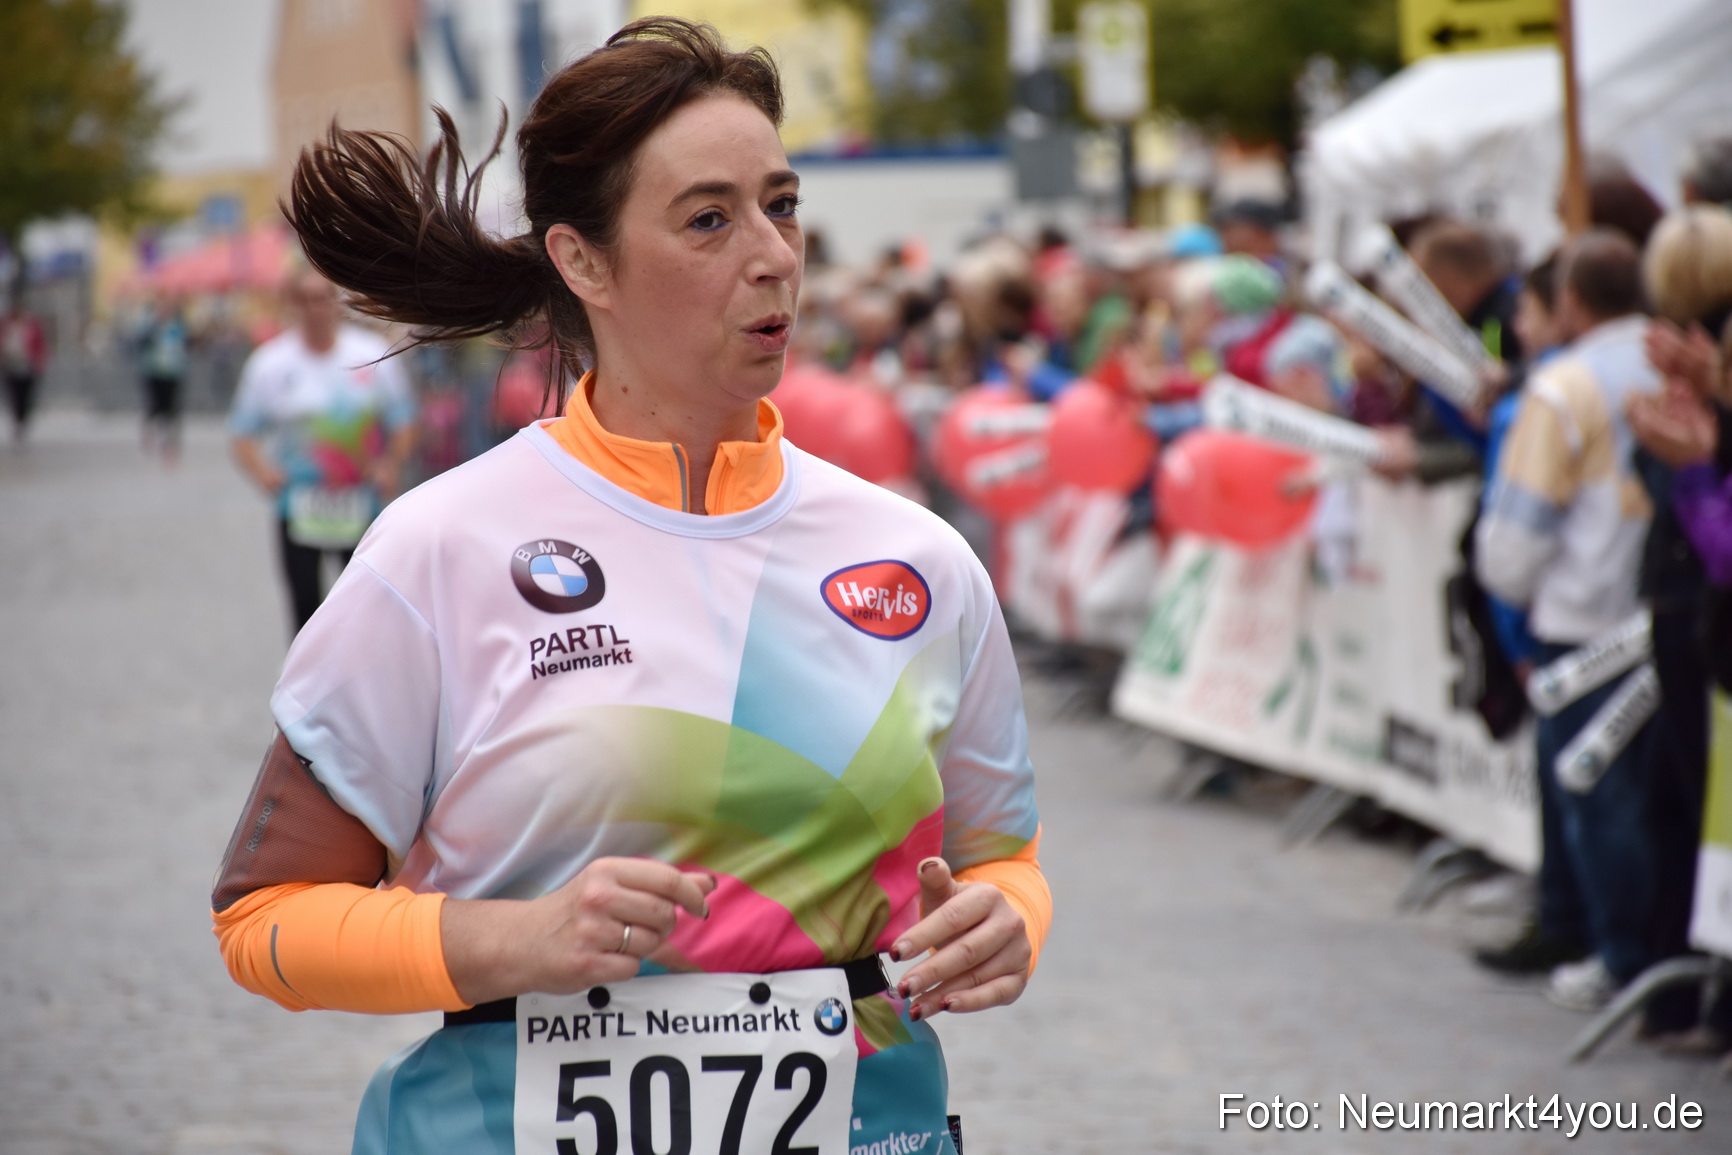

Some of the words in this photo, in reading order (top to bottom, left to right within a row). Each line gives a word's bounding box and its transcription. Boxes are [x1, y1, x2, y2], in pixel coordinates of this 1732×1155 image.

[515, 541, 592, 565] BMW
[835, 581, 918, 619] Hervis
[852, 608, 884, 622] SPORTS
[529, 624, 630, 661] PARTL
[530, 648, 633, 680] Neumarkt
[247, 798, 276, 852] Reebok
[527, 1012, 637, 1044] PARTL
[646, 1005, 801, 1036] Neumarkt
[555, 1051, 828, 1155] 5072
